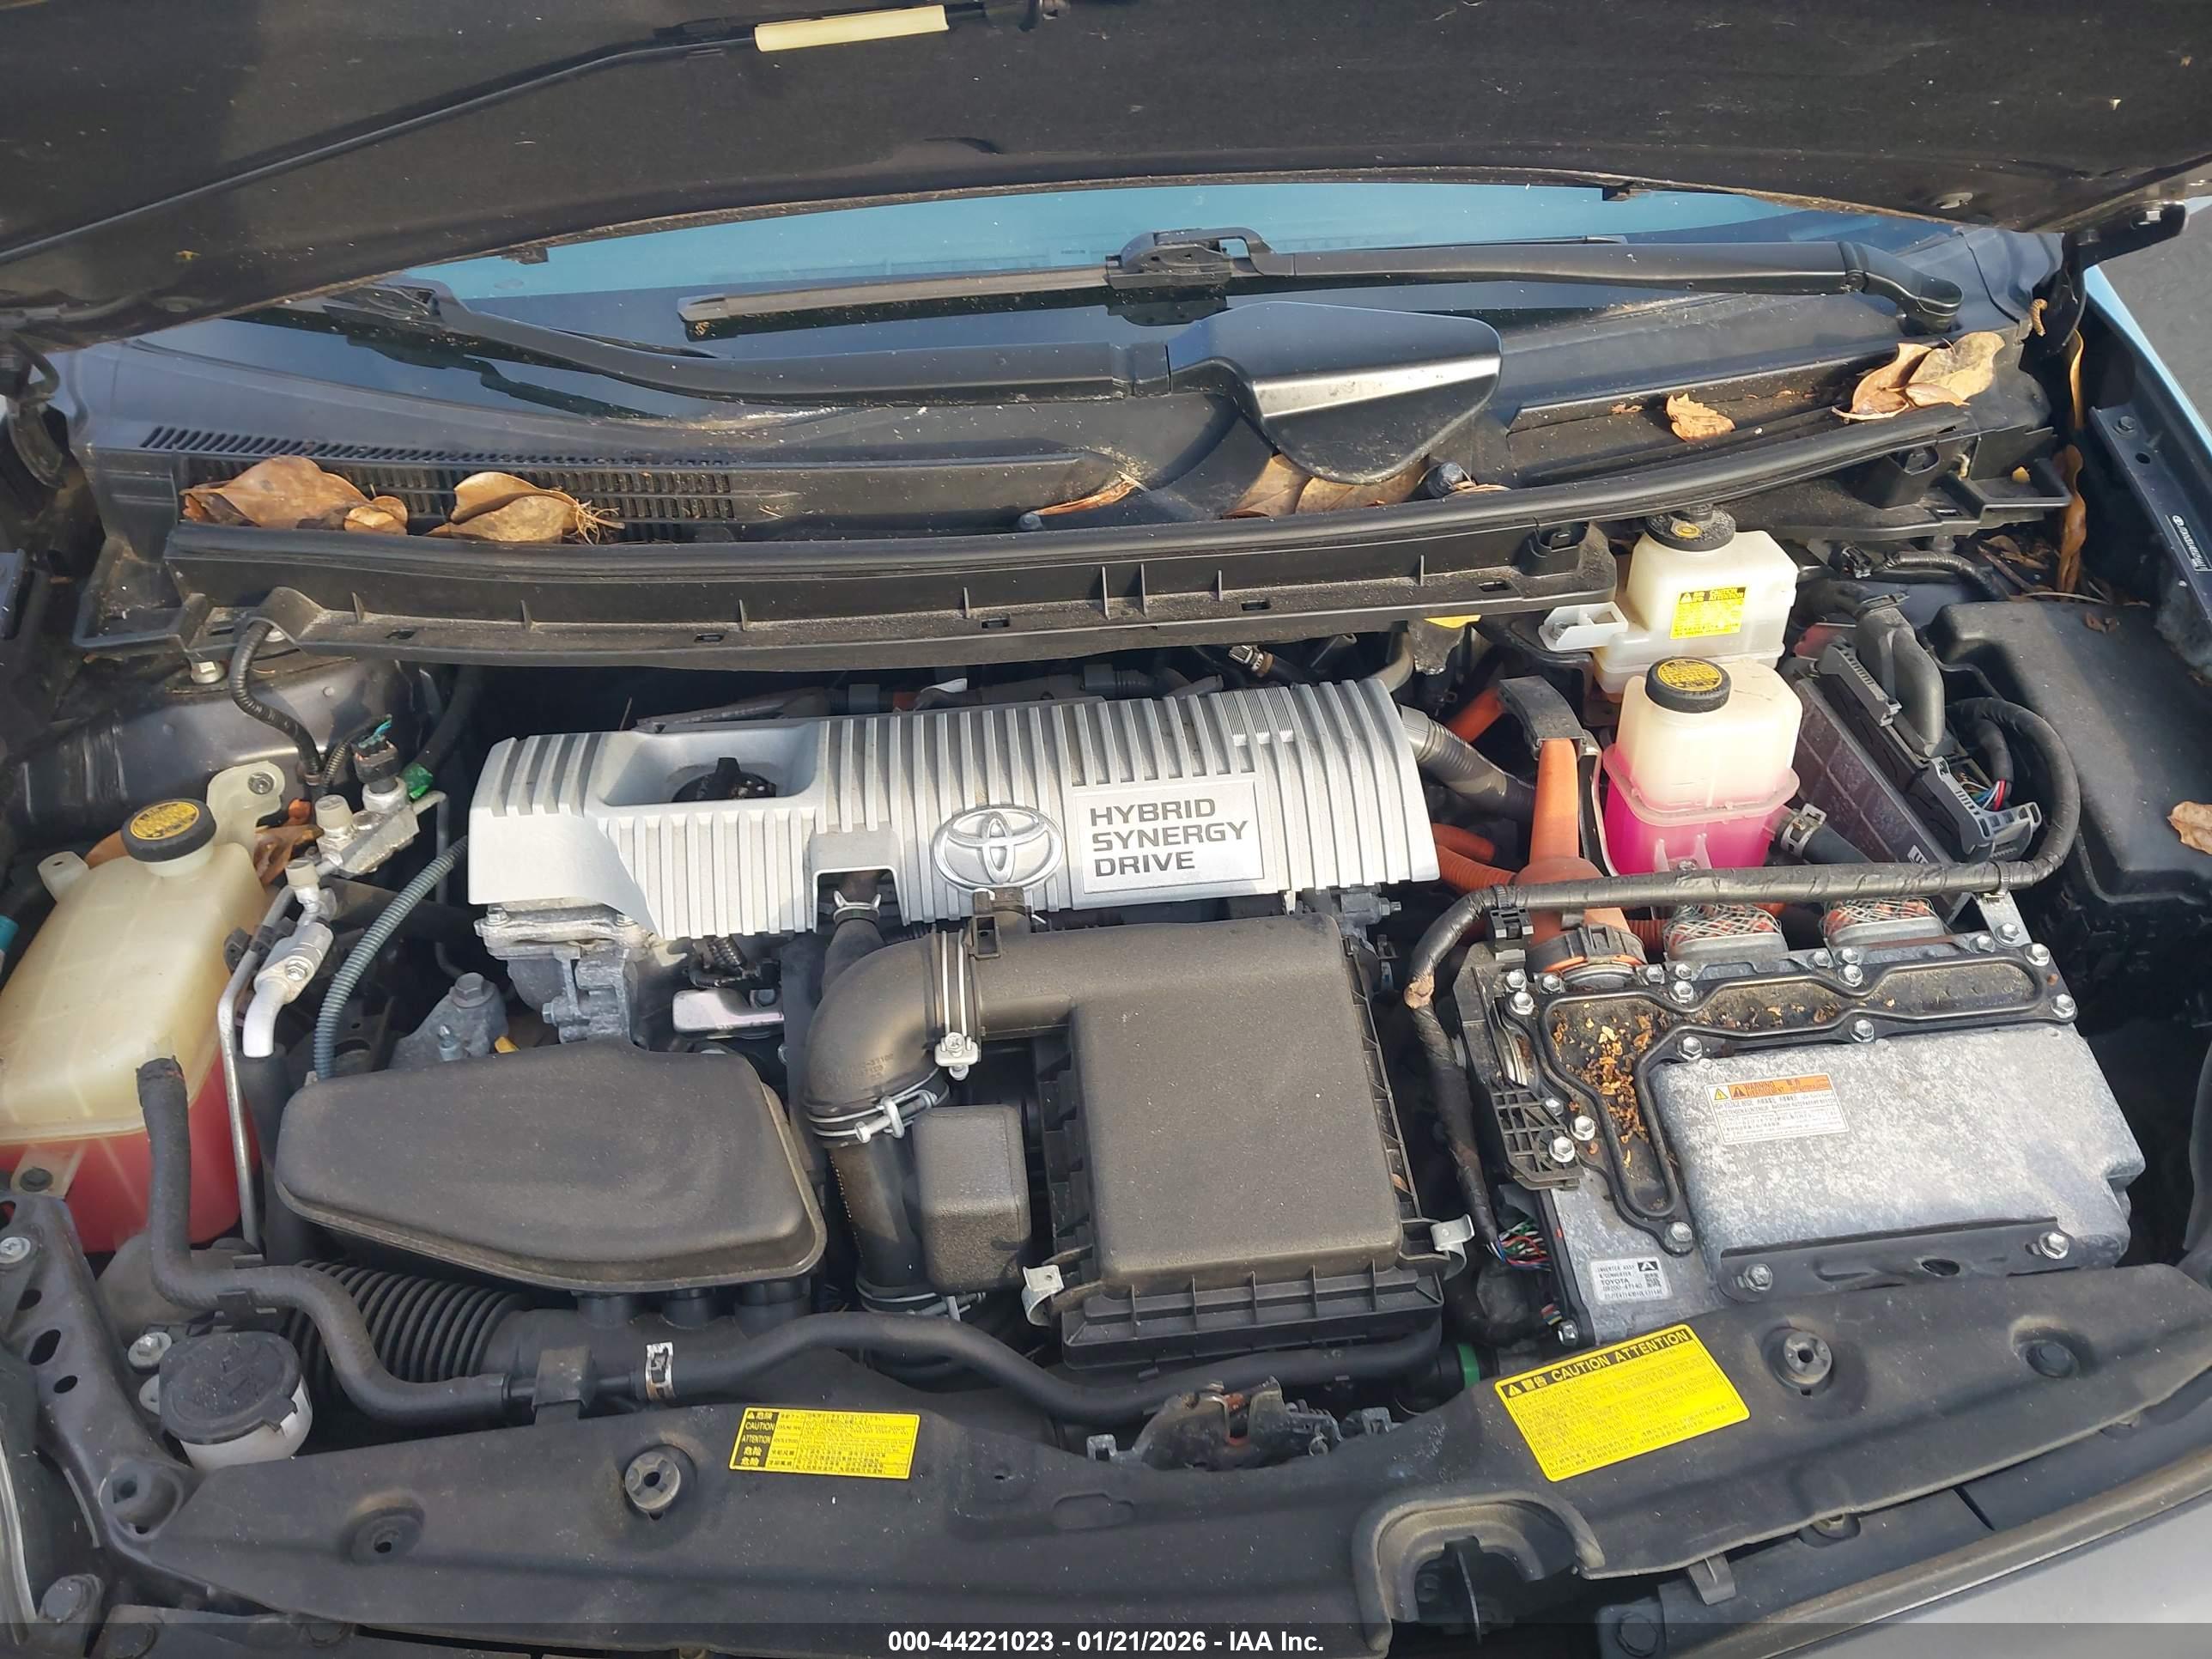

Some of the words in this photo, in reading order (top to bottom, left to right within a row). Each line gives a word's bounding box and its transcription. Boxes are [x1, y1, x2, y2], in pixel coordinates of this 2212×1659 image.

[1090, 797, 1216, 827] HYBRID
[1091, 820, 1249, 853] SYNERGY
[1095, 850, 1196, 878] DRIVE
[1551, 1354, 1611, 1382] CAUTION
[1615, 1329, 1690, 1364] ATTENTION
[741, 1434, 770, 1444] ATTENTION
[744, 1421, 775, 1431] CAUTION
